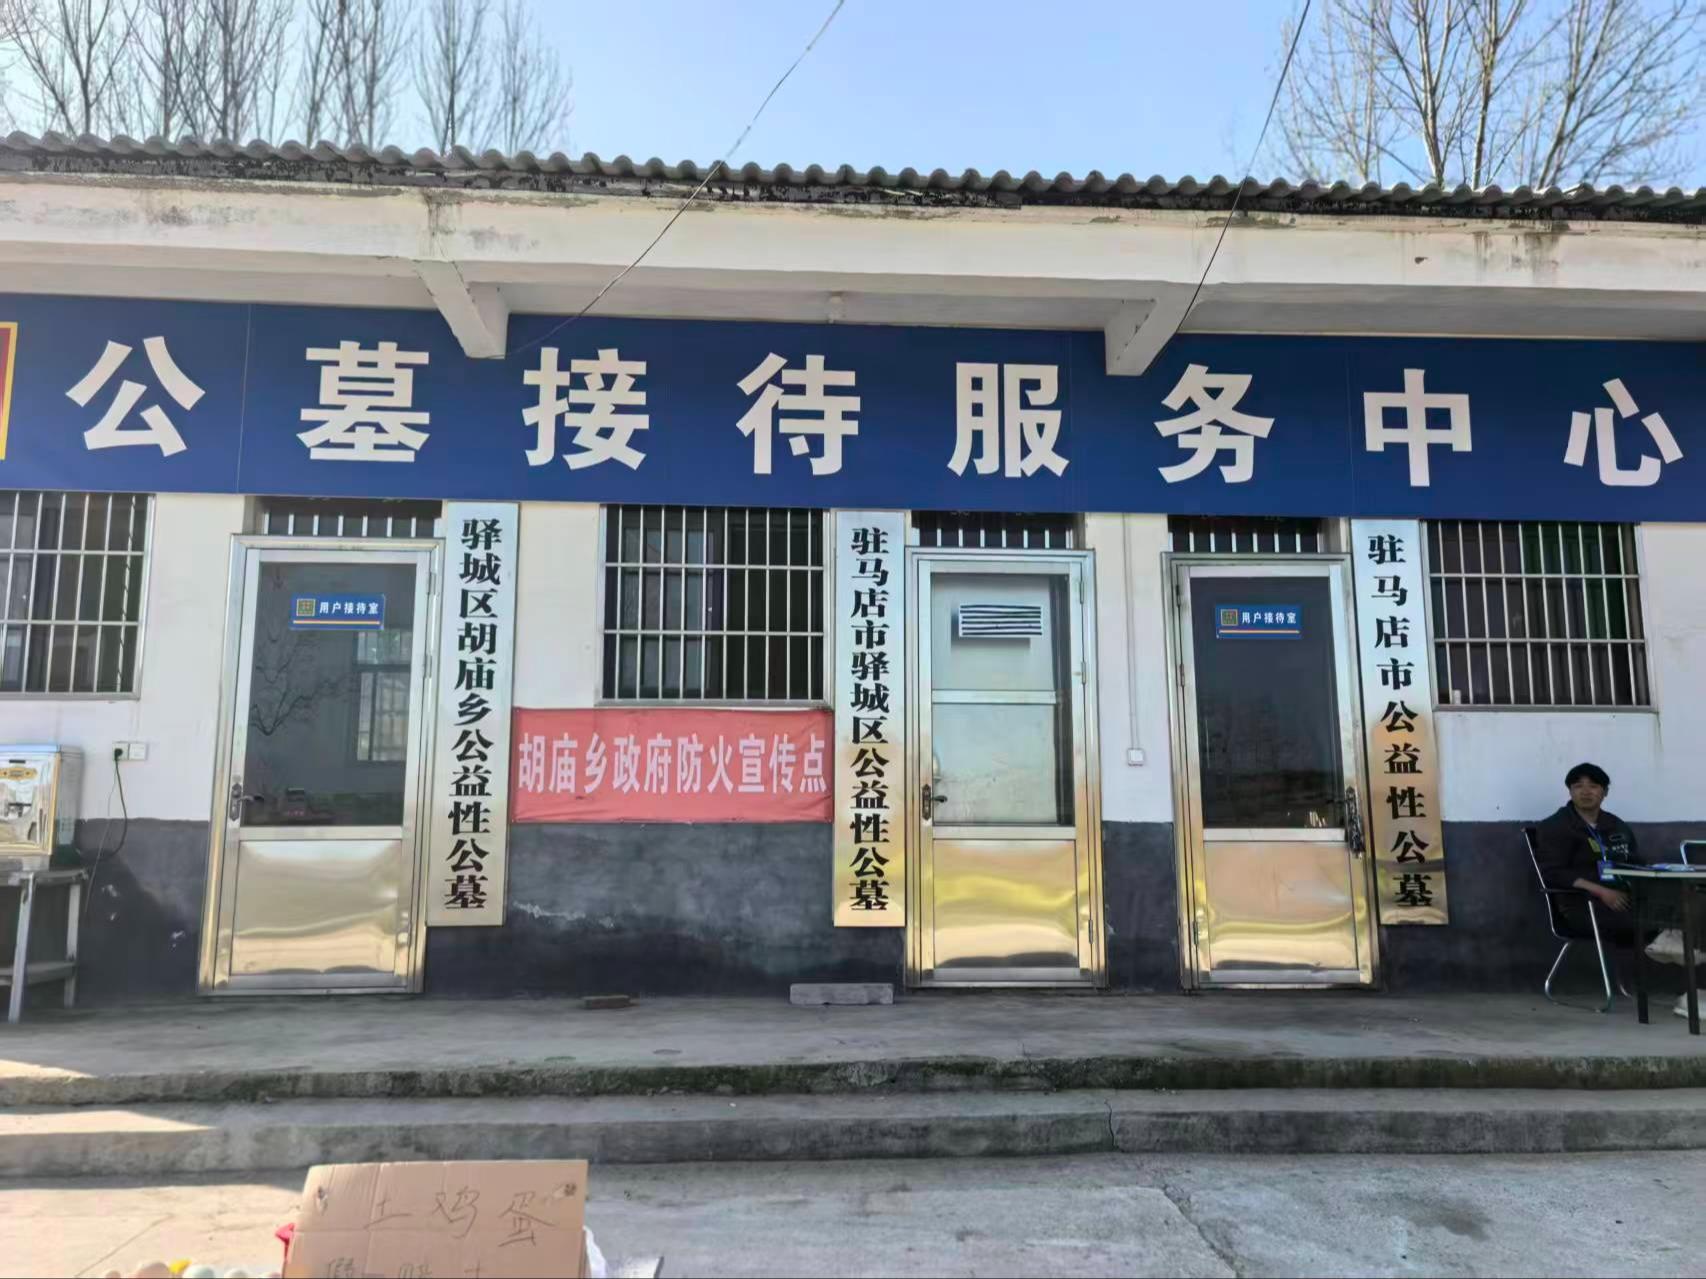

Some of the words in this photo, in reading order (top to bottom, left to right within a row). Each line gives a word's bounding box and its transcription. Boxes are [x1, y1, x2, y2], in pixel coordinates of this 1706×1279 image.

[65, 335, 1685, 487] 公墓接待服务中心
[319, 601, 380, 615] 用户接待室
[1241, 611, 1297, 624] 用户接待室
[444, 518, 503, 911] 驿城区胡庙乡公益性公墓
[518, 732, 828, 795] 胡庙乡政府防火宣传点
[850, 527, 890, 912] 驻马店市驿城区公益性公墓
[1367, 535, 1433, 908] 驻马店市公益性公墓
[363, 1186, 556, 1248] 土鸡蛋
